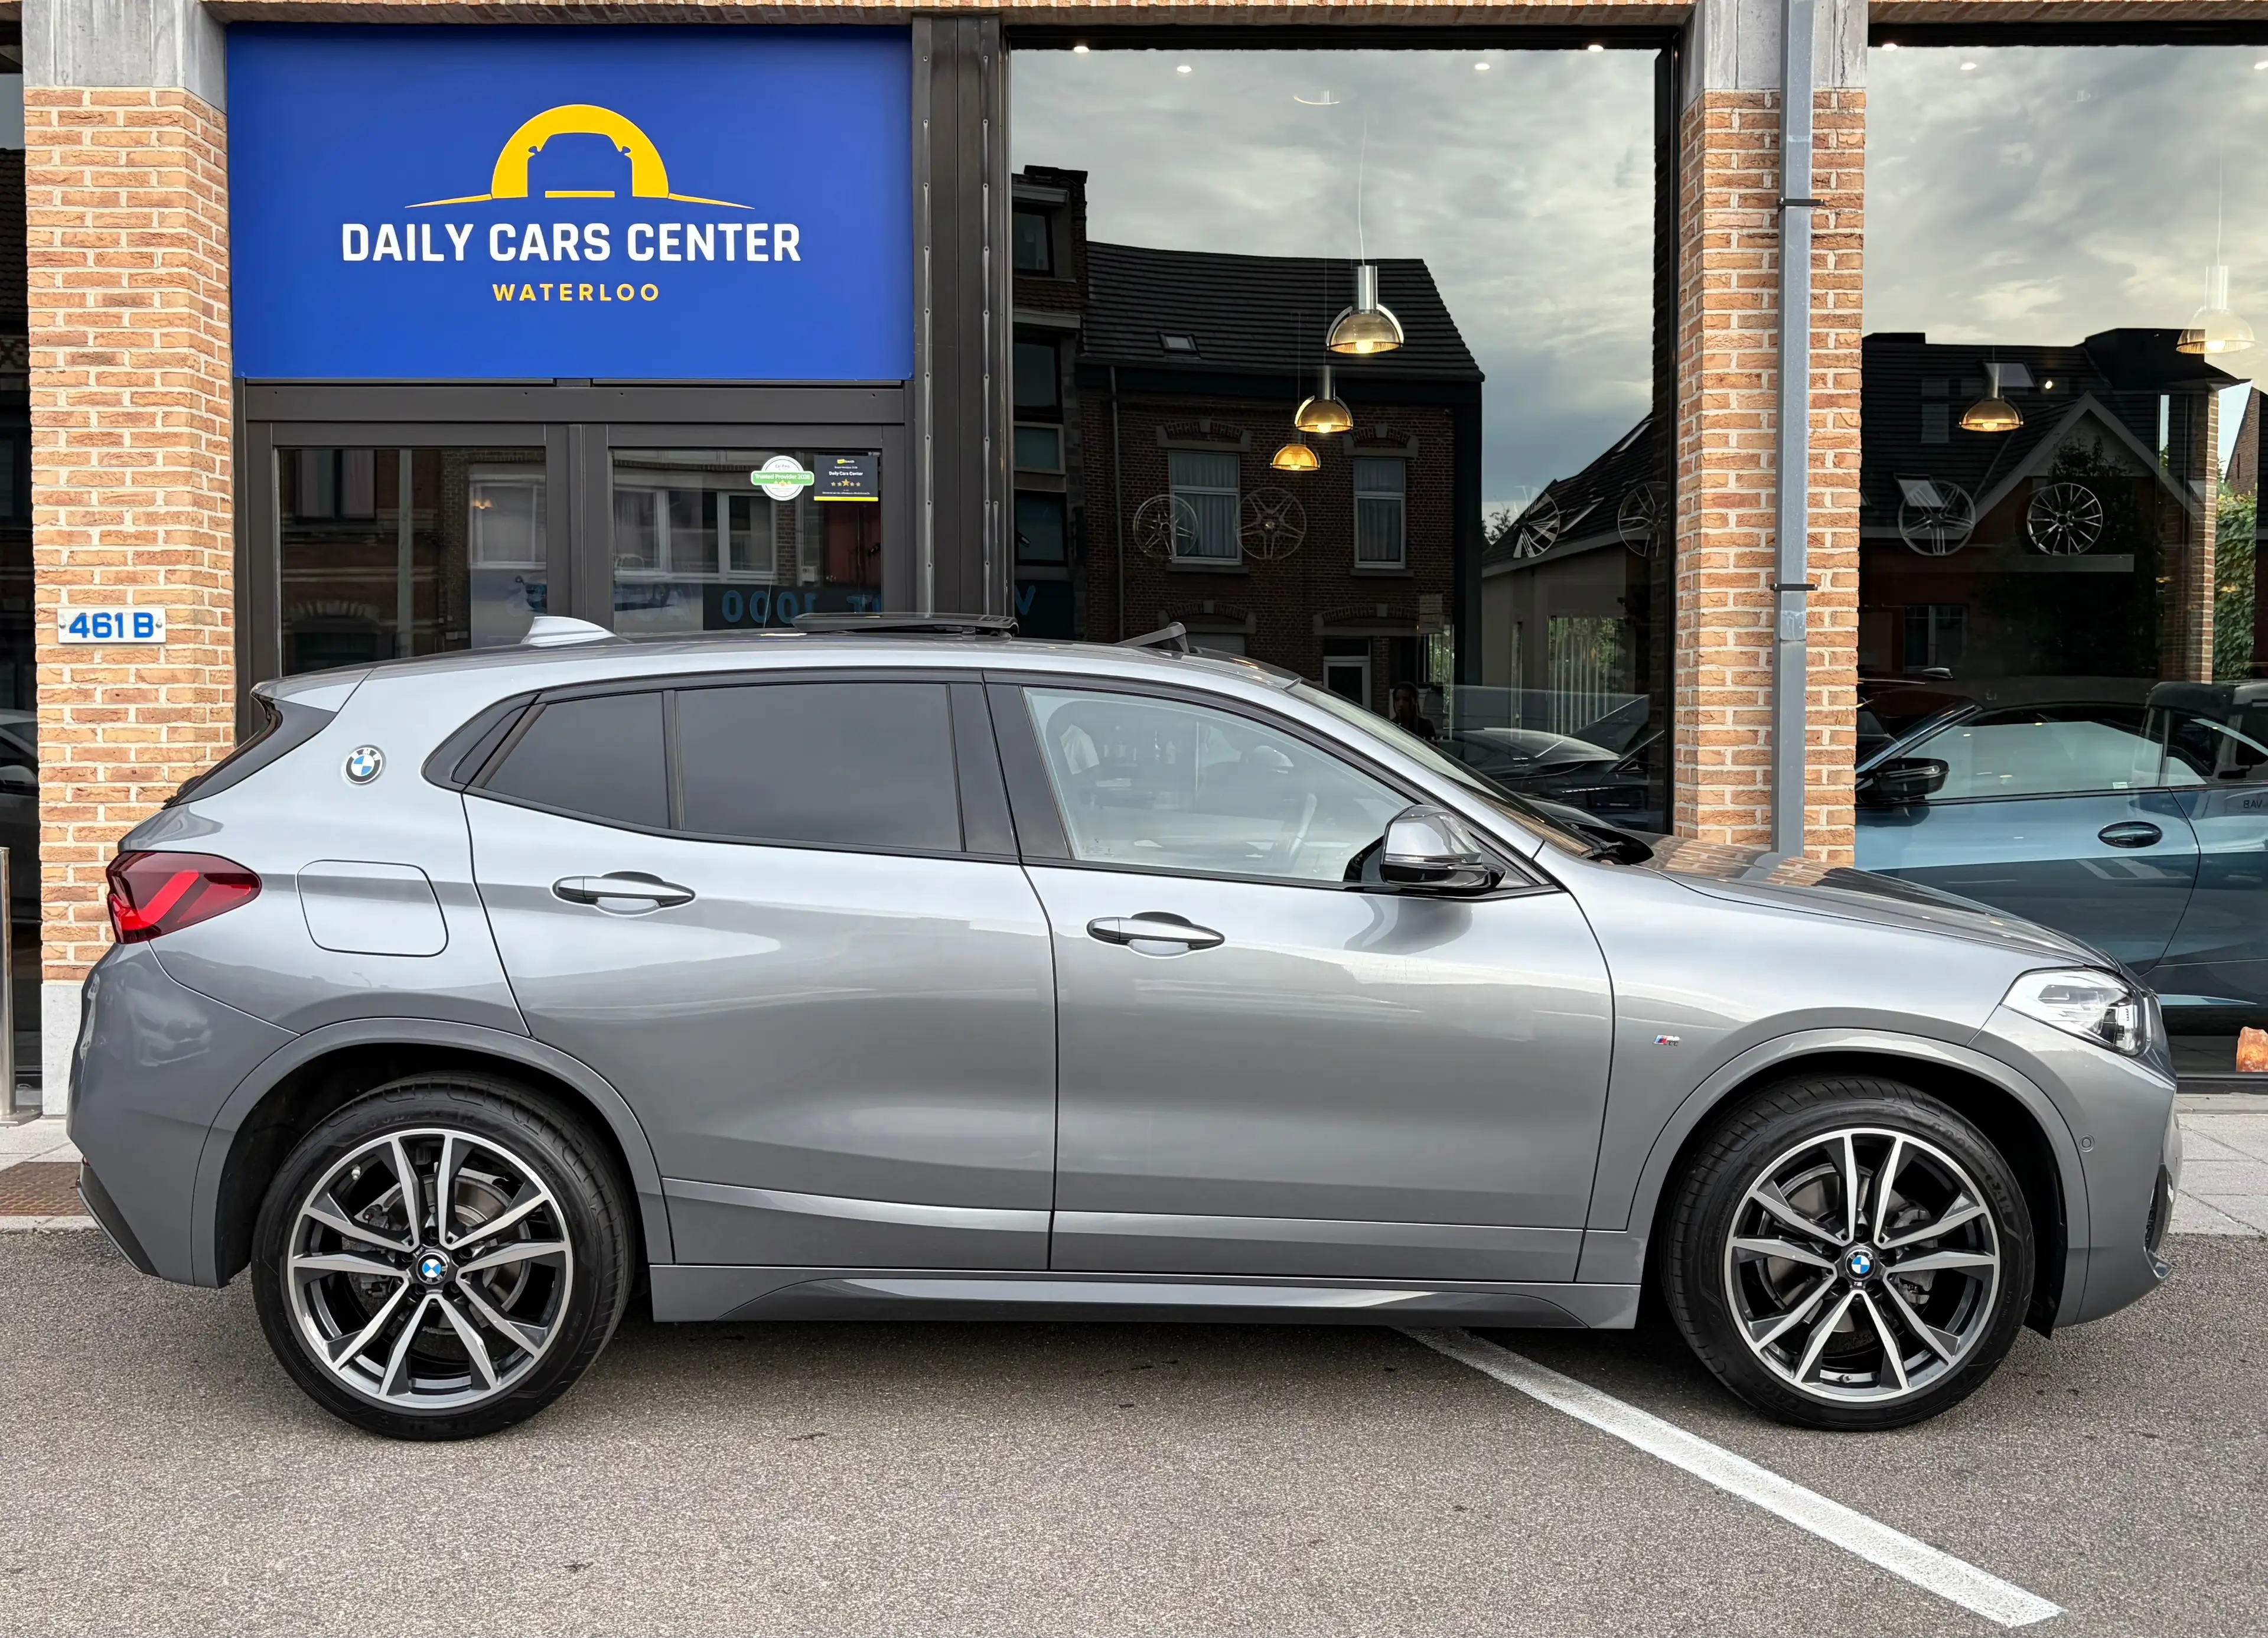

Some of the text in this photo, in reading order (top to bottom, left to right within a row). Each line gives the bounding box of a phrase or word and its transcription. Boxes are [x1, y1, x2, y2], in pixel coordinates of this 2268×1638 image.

[343, 223, 801, 262] DAILY CARS CENTER
[493, 284, 659, 301] WATERLOO
[69, 613, 154, 638] 461 B
